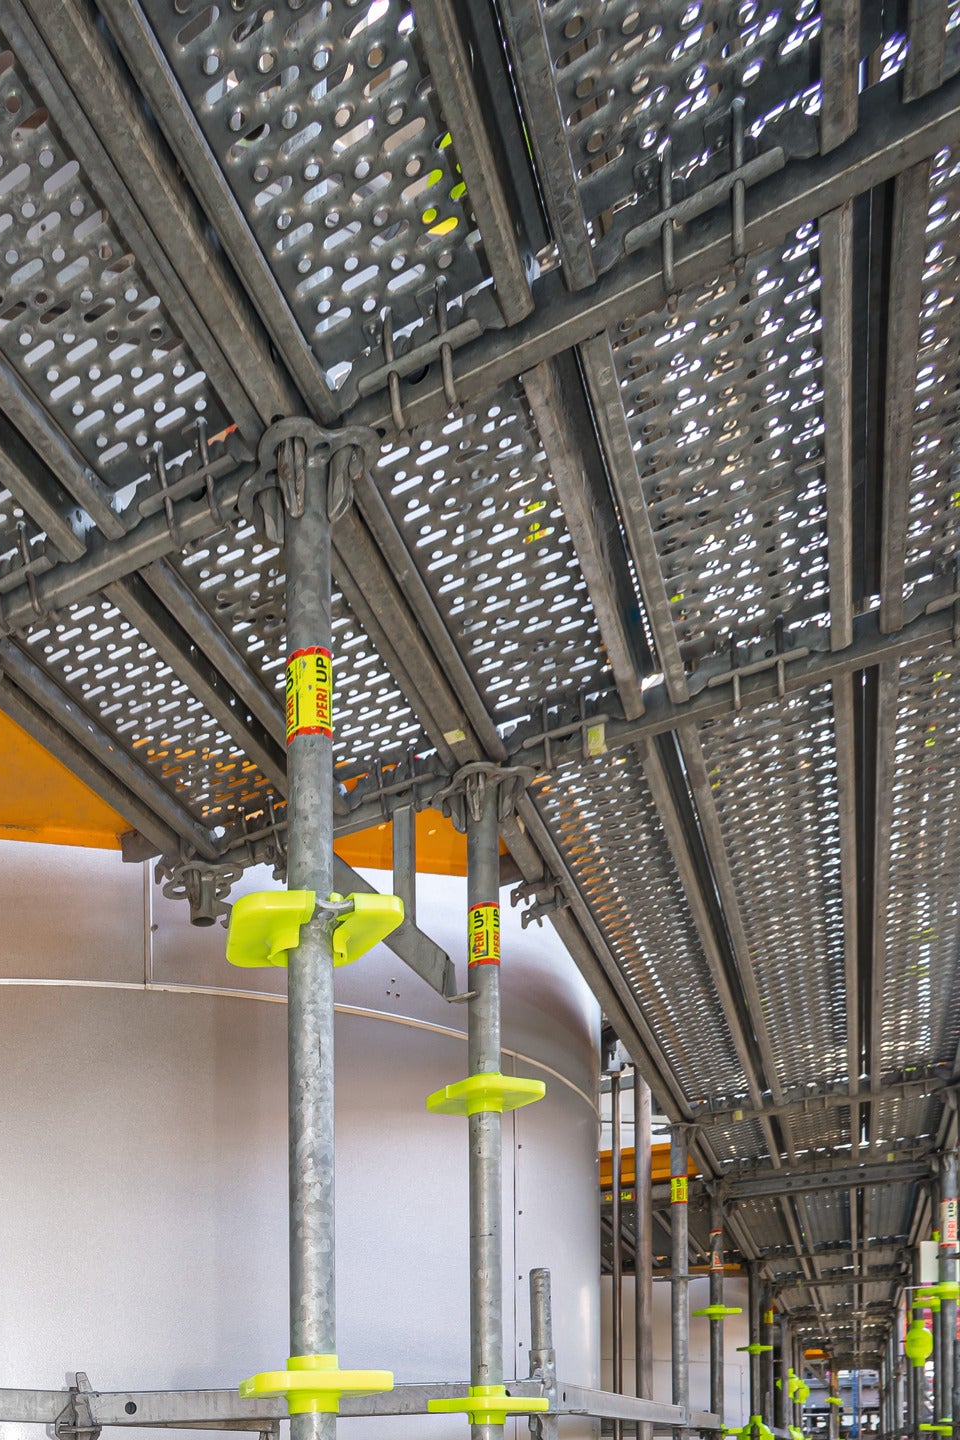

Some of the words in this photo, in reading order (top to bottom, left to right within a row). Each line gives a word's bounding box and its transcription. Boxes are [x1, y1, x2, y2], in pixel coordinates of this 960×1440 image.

[316, 656, 327, 682] UP
[316, 688, 327, 719] PERI
[474, 910, 484, 929] UP
[474, 931, 484, 956] PERI
